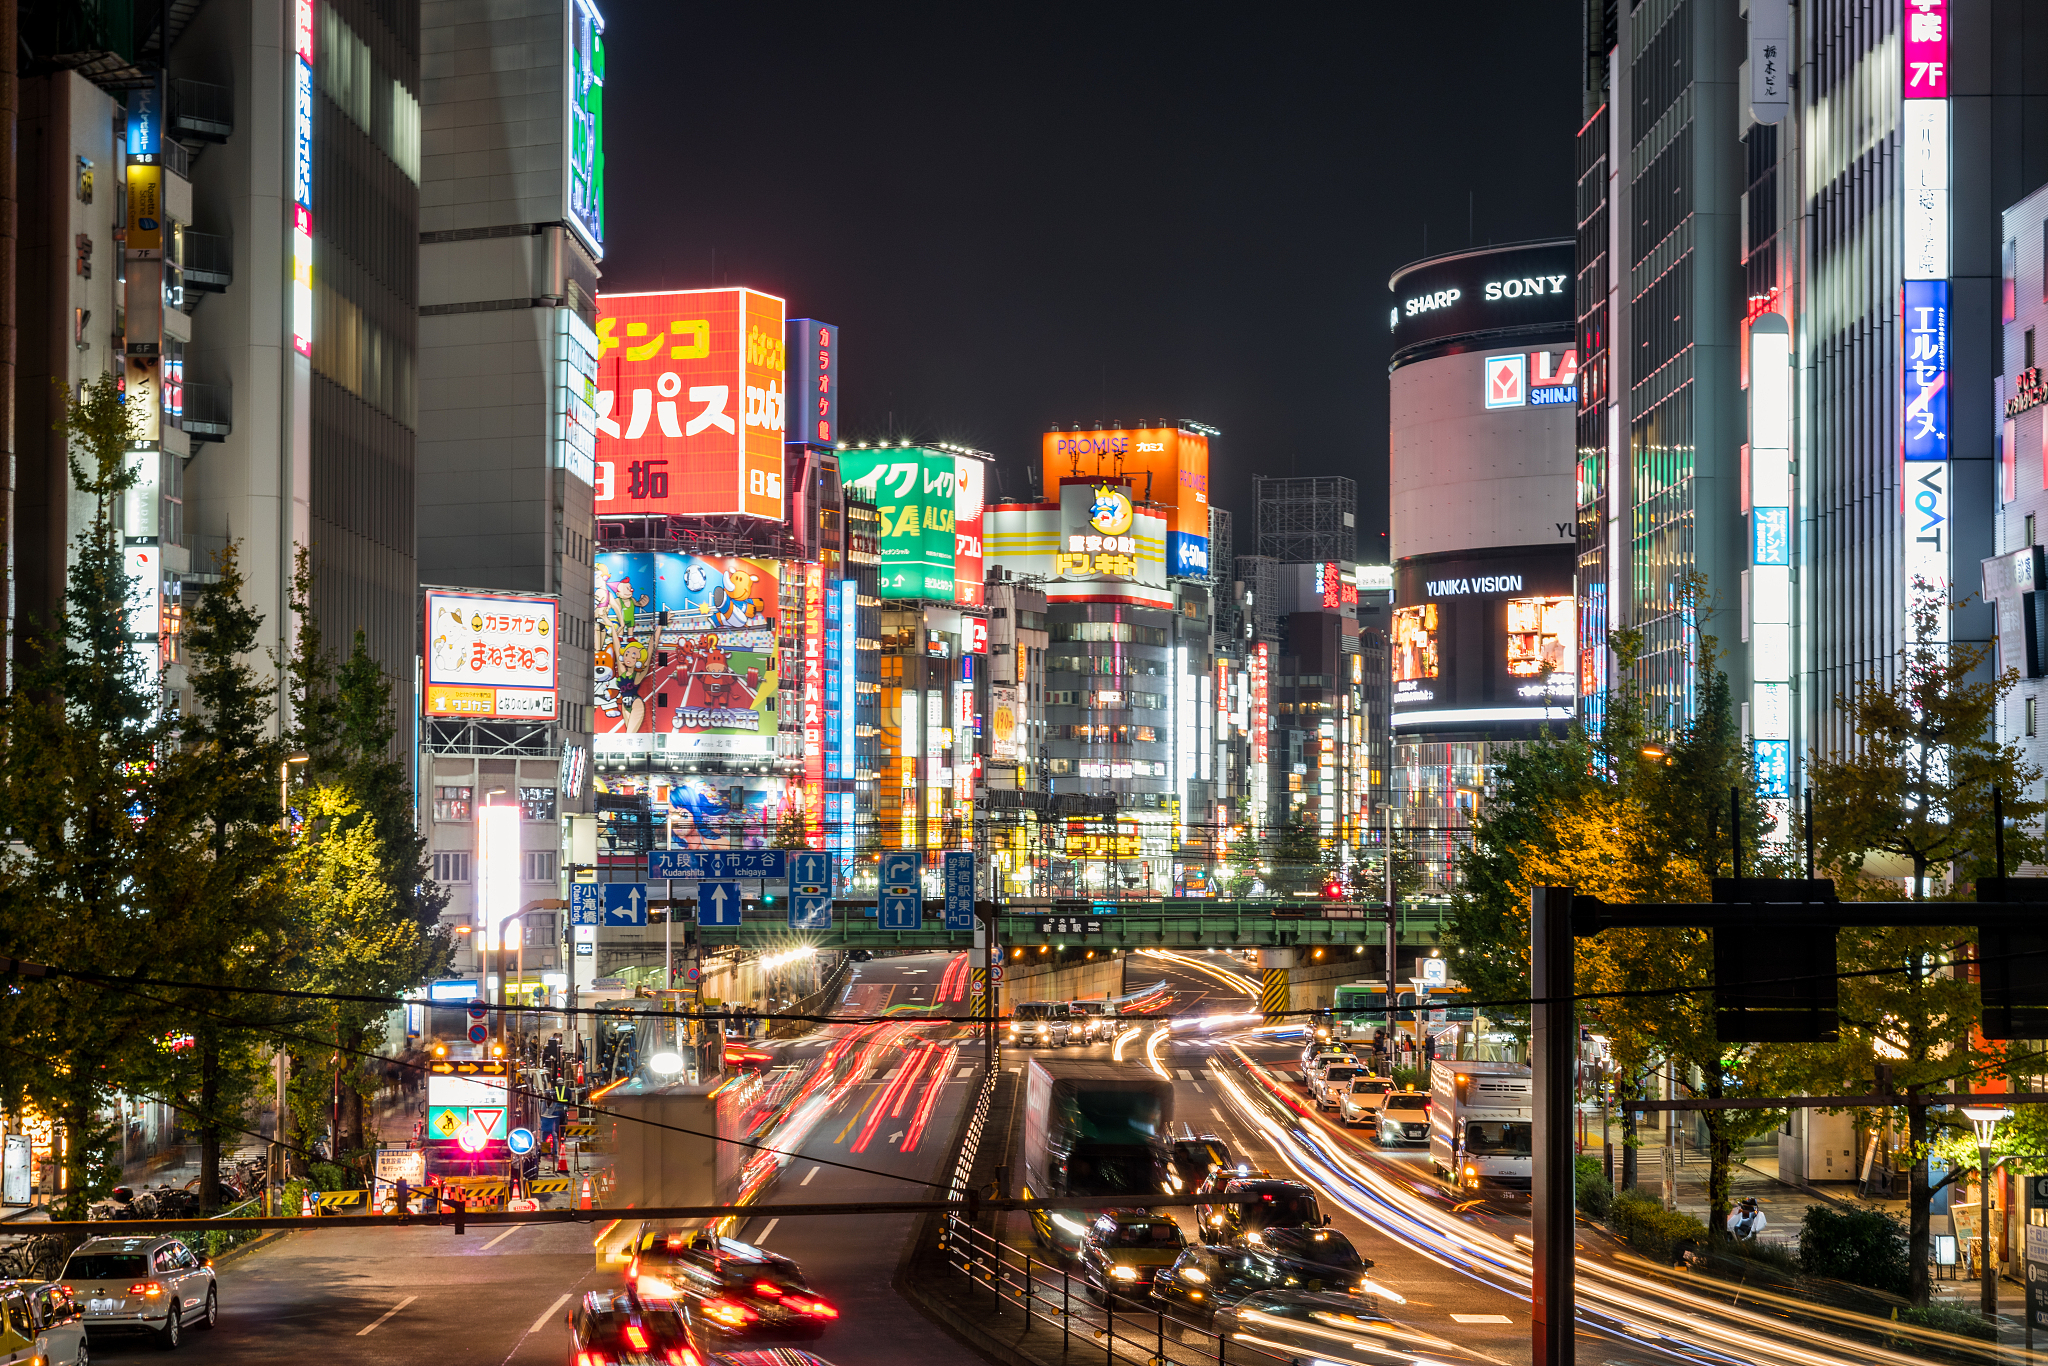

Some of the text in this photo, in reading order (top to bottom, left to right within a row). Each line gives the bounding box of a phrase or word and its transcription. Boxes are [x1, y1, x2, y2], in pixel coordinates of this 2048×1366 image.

[1909, 62, 1943, 87] 7F
[148, 182, 156, 216] Rosetta
[137, 250, 150, 258] 7F
[1405, 275, 1567, 317] SHARP SONY
[136, 344, 150, 353] 6F
[747, 324, 785, 372] パチンコ
[1910, 307, 1938, 441] エルセーヌ
[134, 440, 151, 449] 5F
[1057, 437, 1129, 455] PROMISE
[923, 467, 955, 498] レイク
[1179, 469, 1206, 492] PROMISE
[922, 505, 955, 534] ALSA
[955, 533, 982, 558] アコム
[1766, 510, 1780, 563] オアシス
[1188, 544, 1207, 568] 50m
[1426, 575, 1522, 597] YUNIKA VISION
[806, 568, 820, 634] パチンコ
[486, 614, 536, 634] カラオケ
[470, 638, 549, 672] まねきねこ
[452, 699, 492, 712] ワンカラ
[671, 705, 760, 731] JUGGLER
[658, 853, 710, 867] 九段下
[662, 868, 705, 877] Kudanshita
[714, 860, 721, 869] 4
[735, 868, 767, 878] Ichigaya
[948, 857, 958, 893] Shinjuku
[957, 855, 971, 926] 新宿駅東口
[572, 885, 581, 924] Otaki Brdg.
[582, 885, 597, 924] 小滝橋
[1042, 923, 1082, 933] 新宿駅
